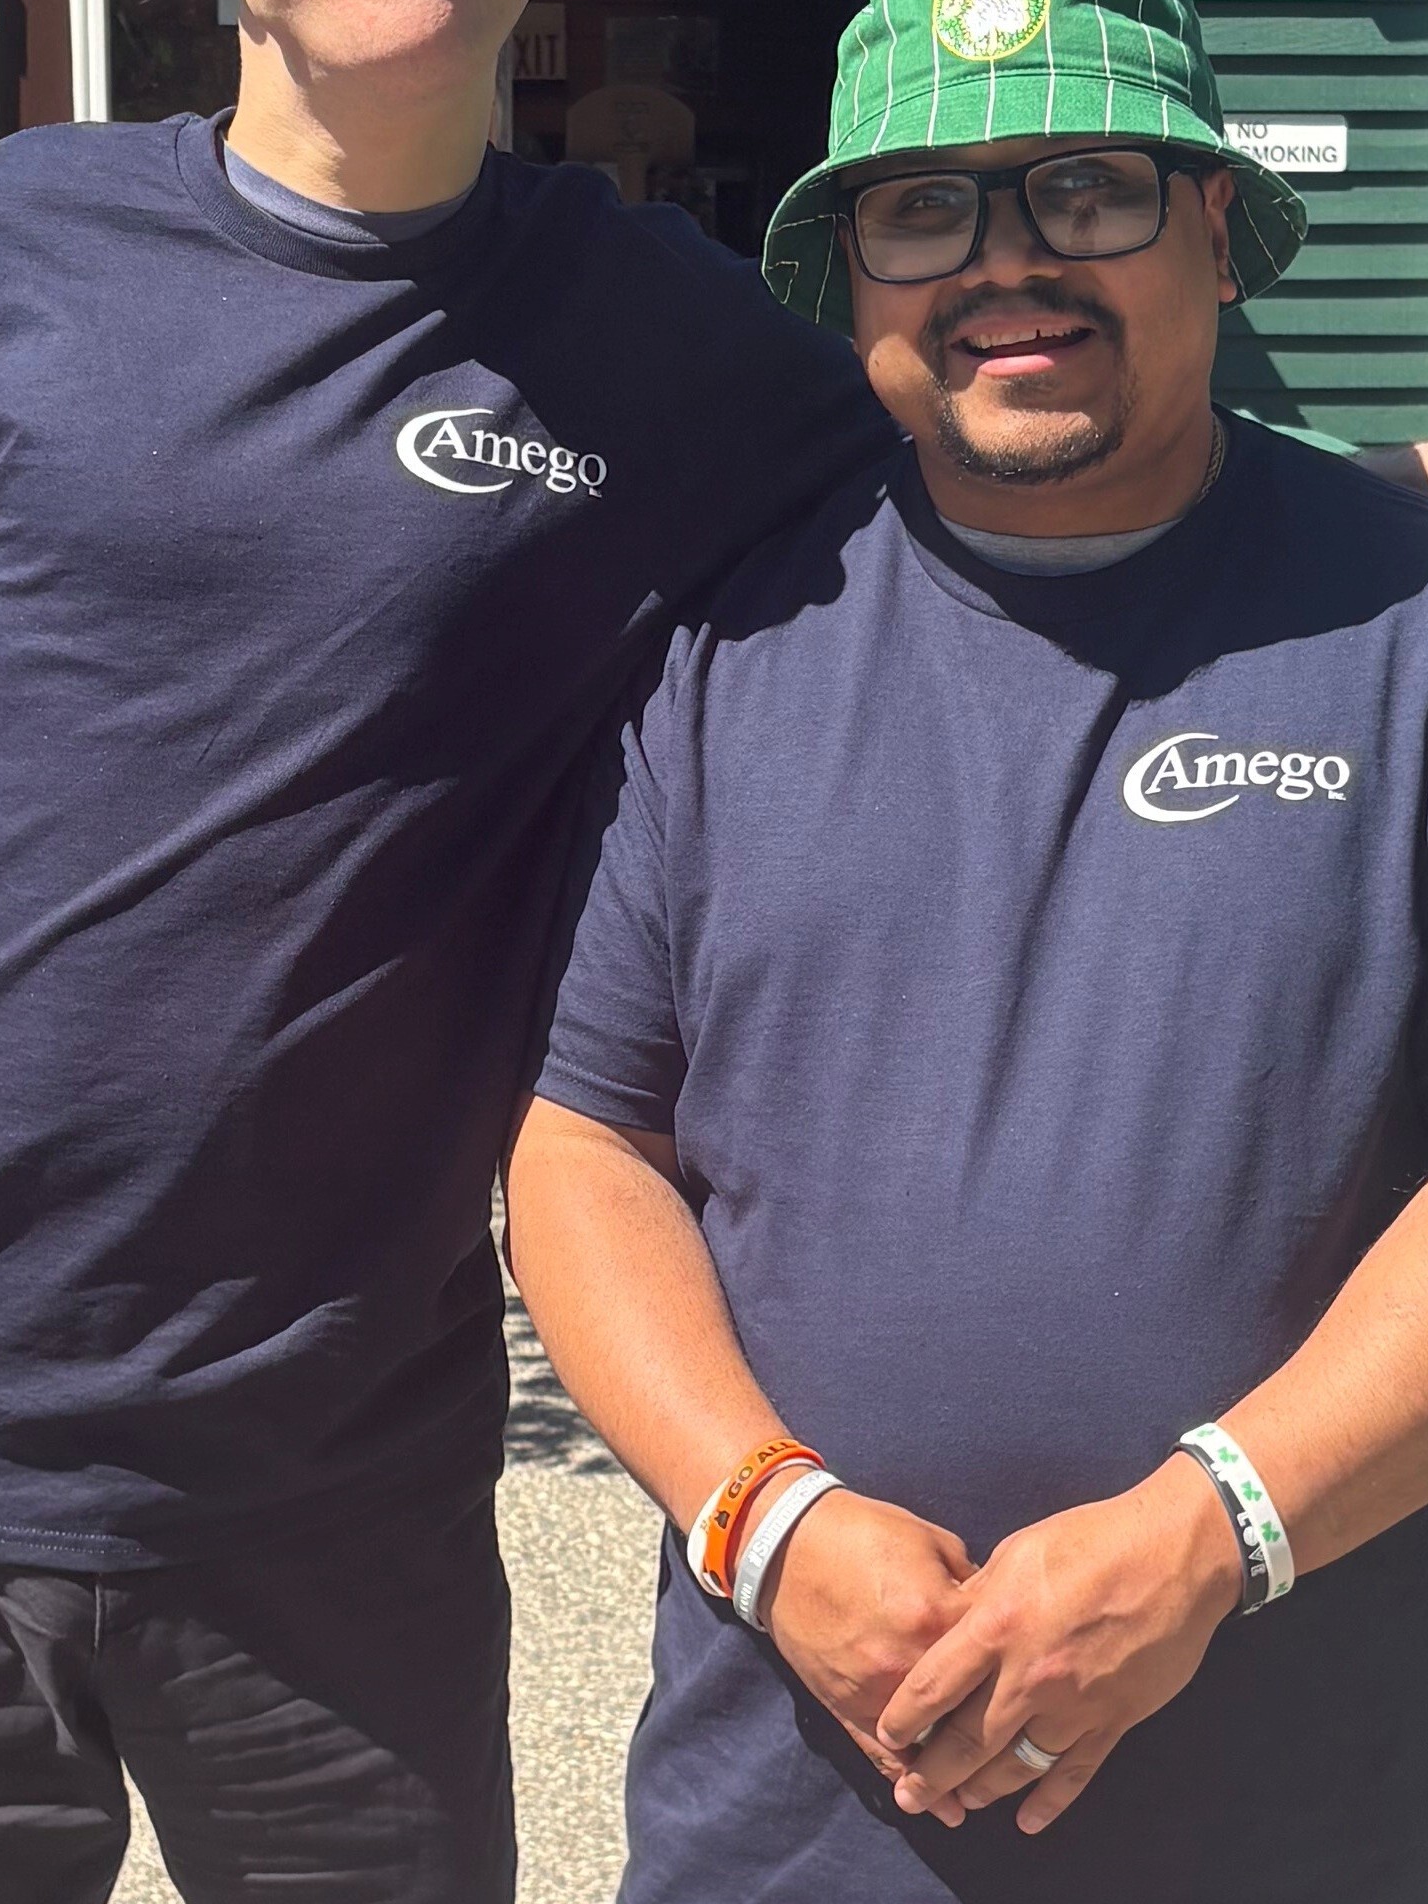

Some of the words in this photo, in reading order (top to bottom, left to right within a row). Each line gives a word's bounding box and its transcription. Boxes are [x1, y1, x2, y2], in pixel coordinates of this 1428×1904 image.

[513, 33, 558, 76] XIT
[1237, 122, 1268, 139] NO
[418, 416, 608, 495] Amego
[1141, 743, 1351, 802] Amego
[728, 1465, 753, 1499] GO
